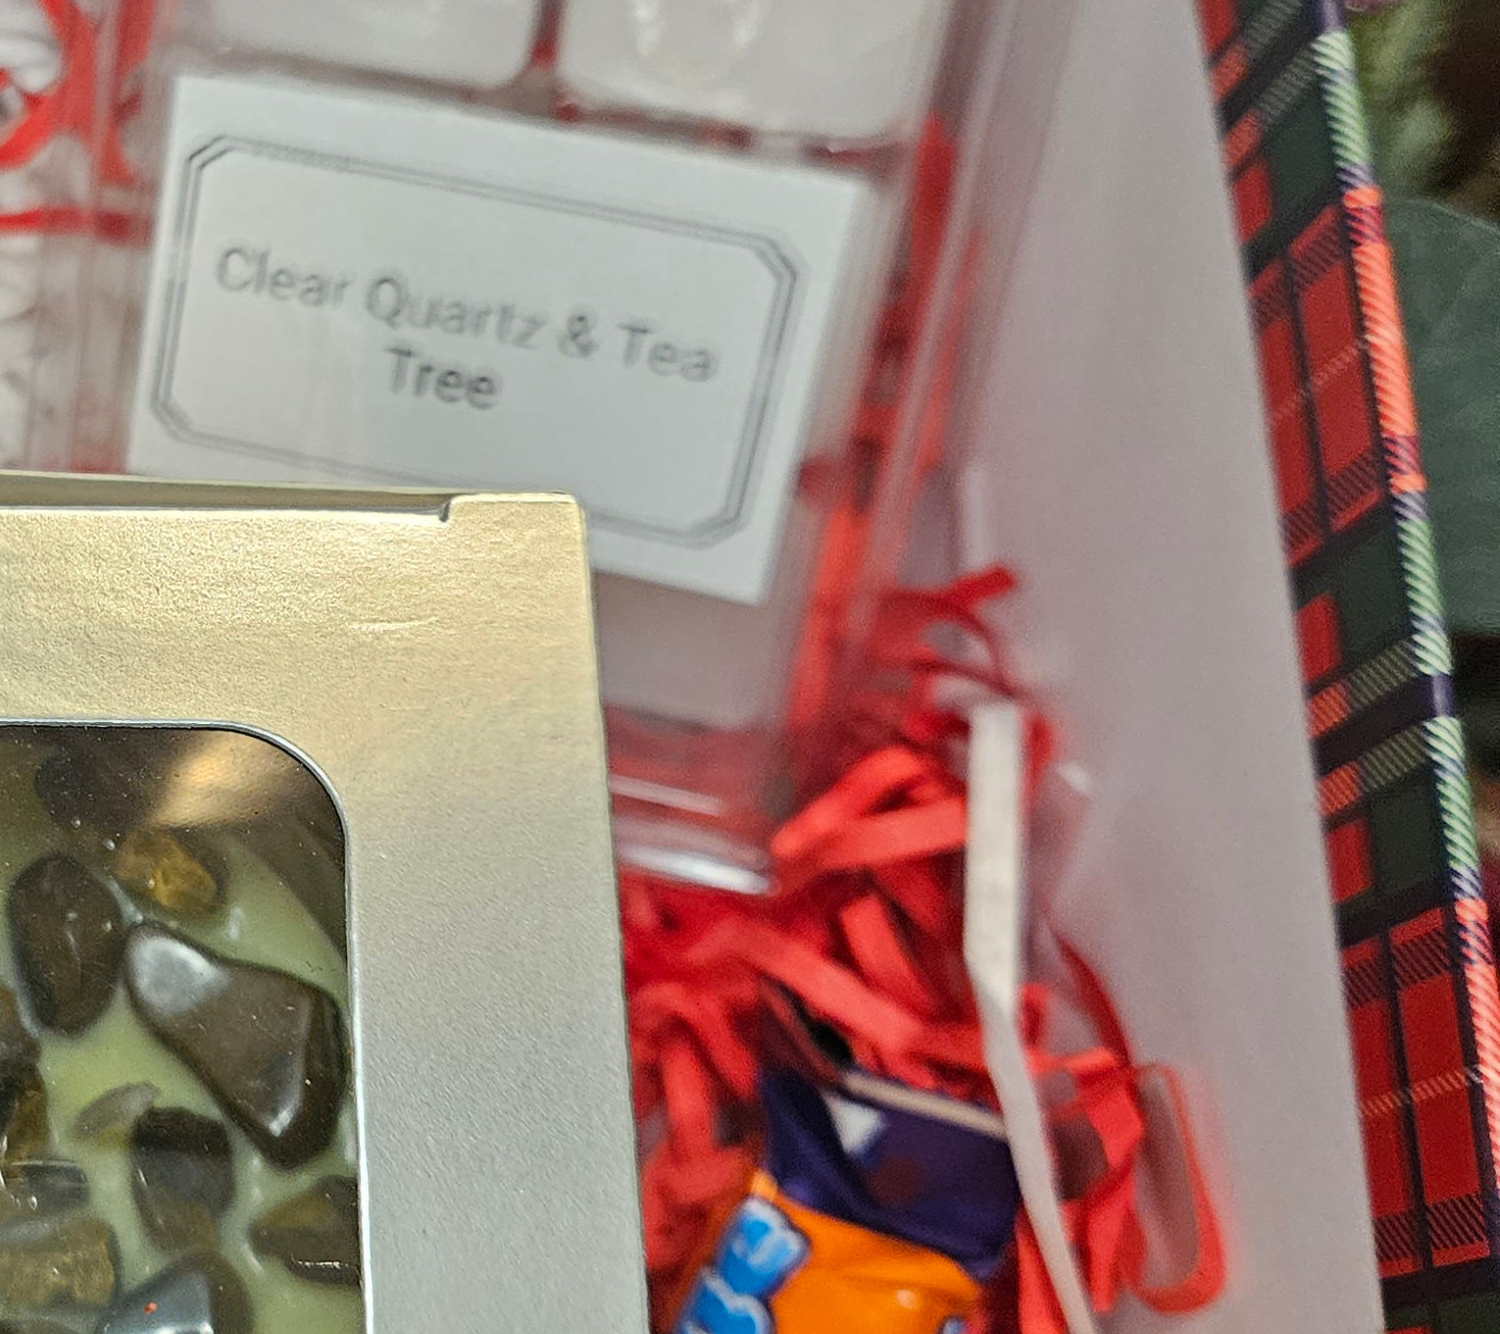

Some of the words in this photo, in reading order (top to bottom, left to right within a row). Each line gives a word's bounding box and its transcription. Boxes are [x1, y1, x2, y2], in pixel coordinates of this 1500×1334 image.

[214, 245, 350, 310] Clear
[363, 276, 548, 350] Quartz
[556, 313, 601, 361] &
[617, 319, 720, 383] Tea
[383, 346, 500, 411] Tree
